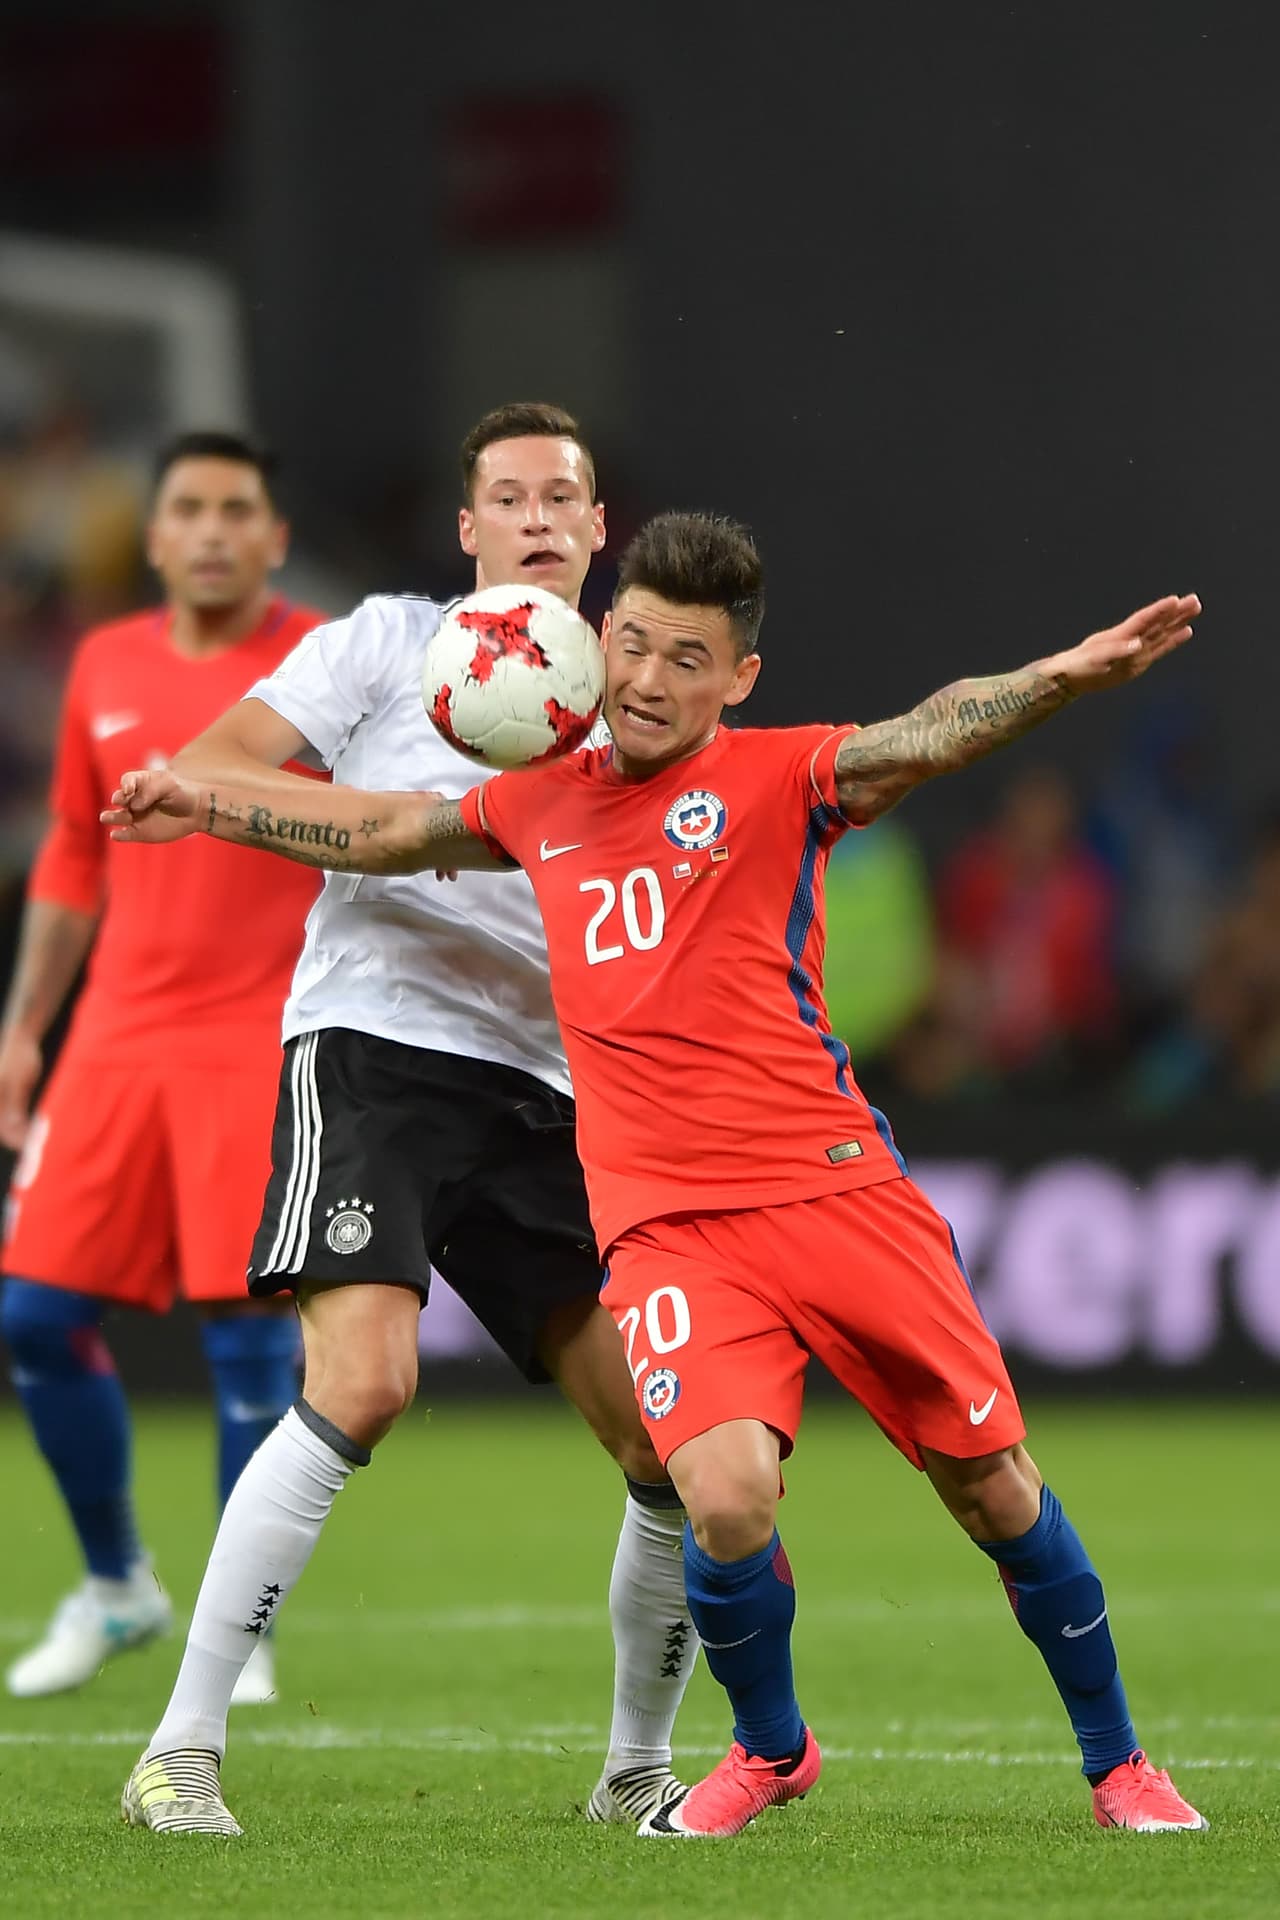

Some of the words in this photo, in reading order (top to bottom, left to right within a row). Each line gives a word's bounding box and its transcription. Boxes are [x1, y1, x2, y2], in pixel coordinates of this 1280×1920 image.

[246, 804, 352, 851] Renato
[579, 866, 666, 966] 20
[905, 1157, 1280, 1370] zer
[617, 1285, 691, 1390] 20
